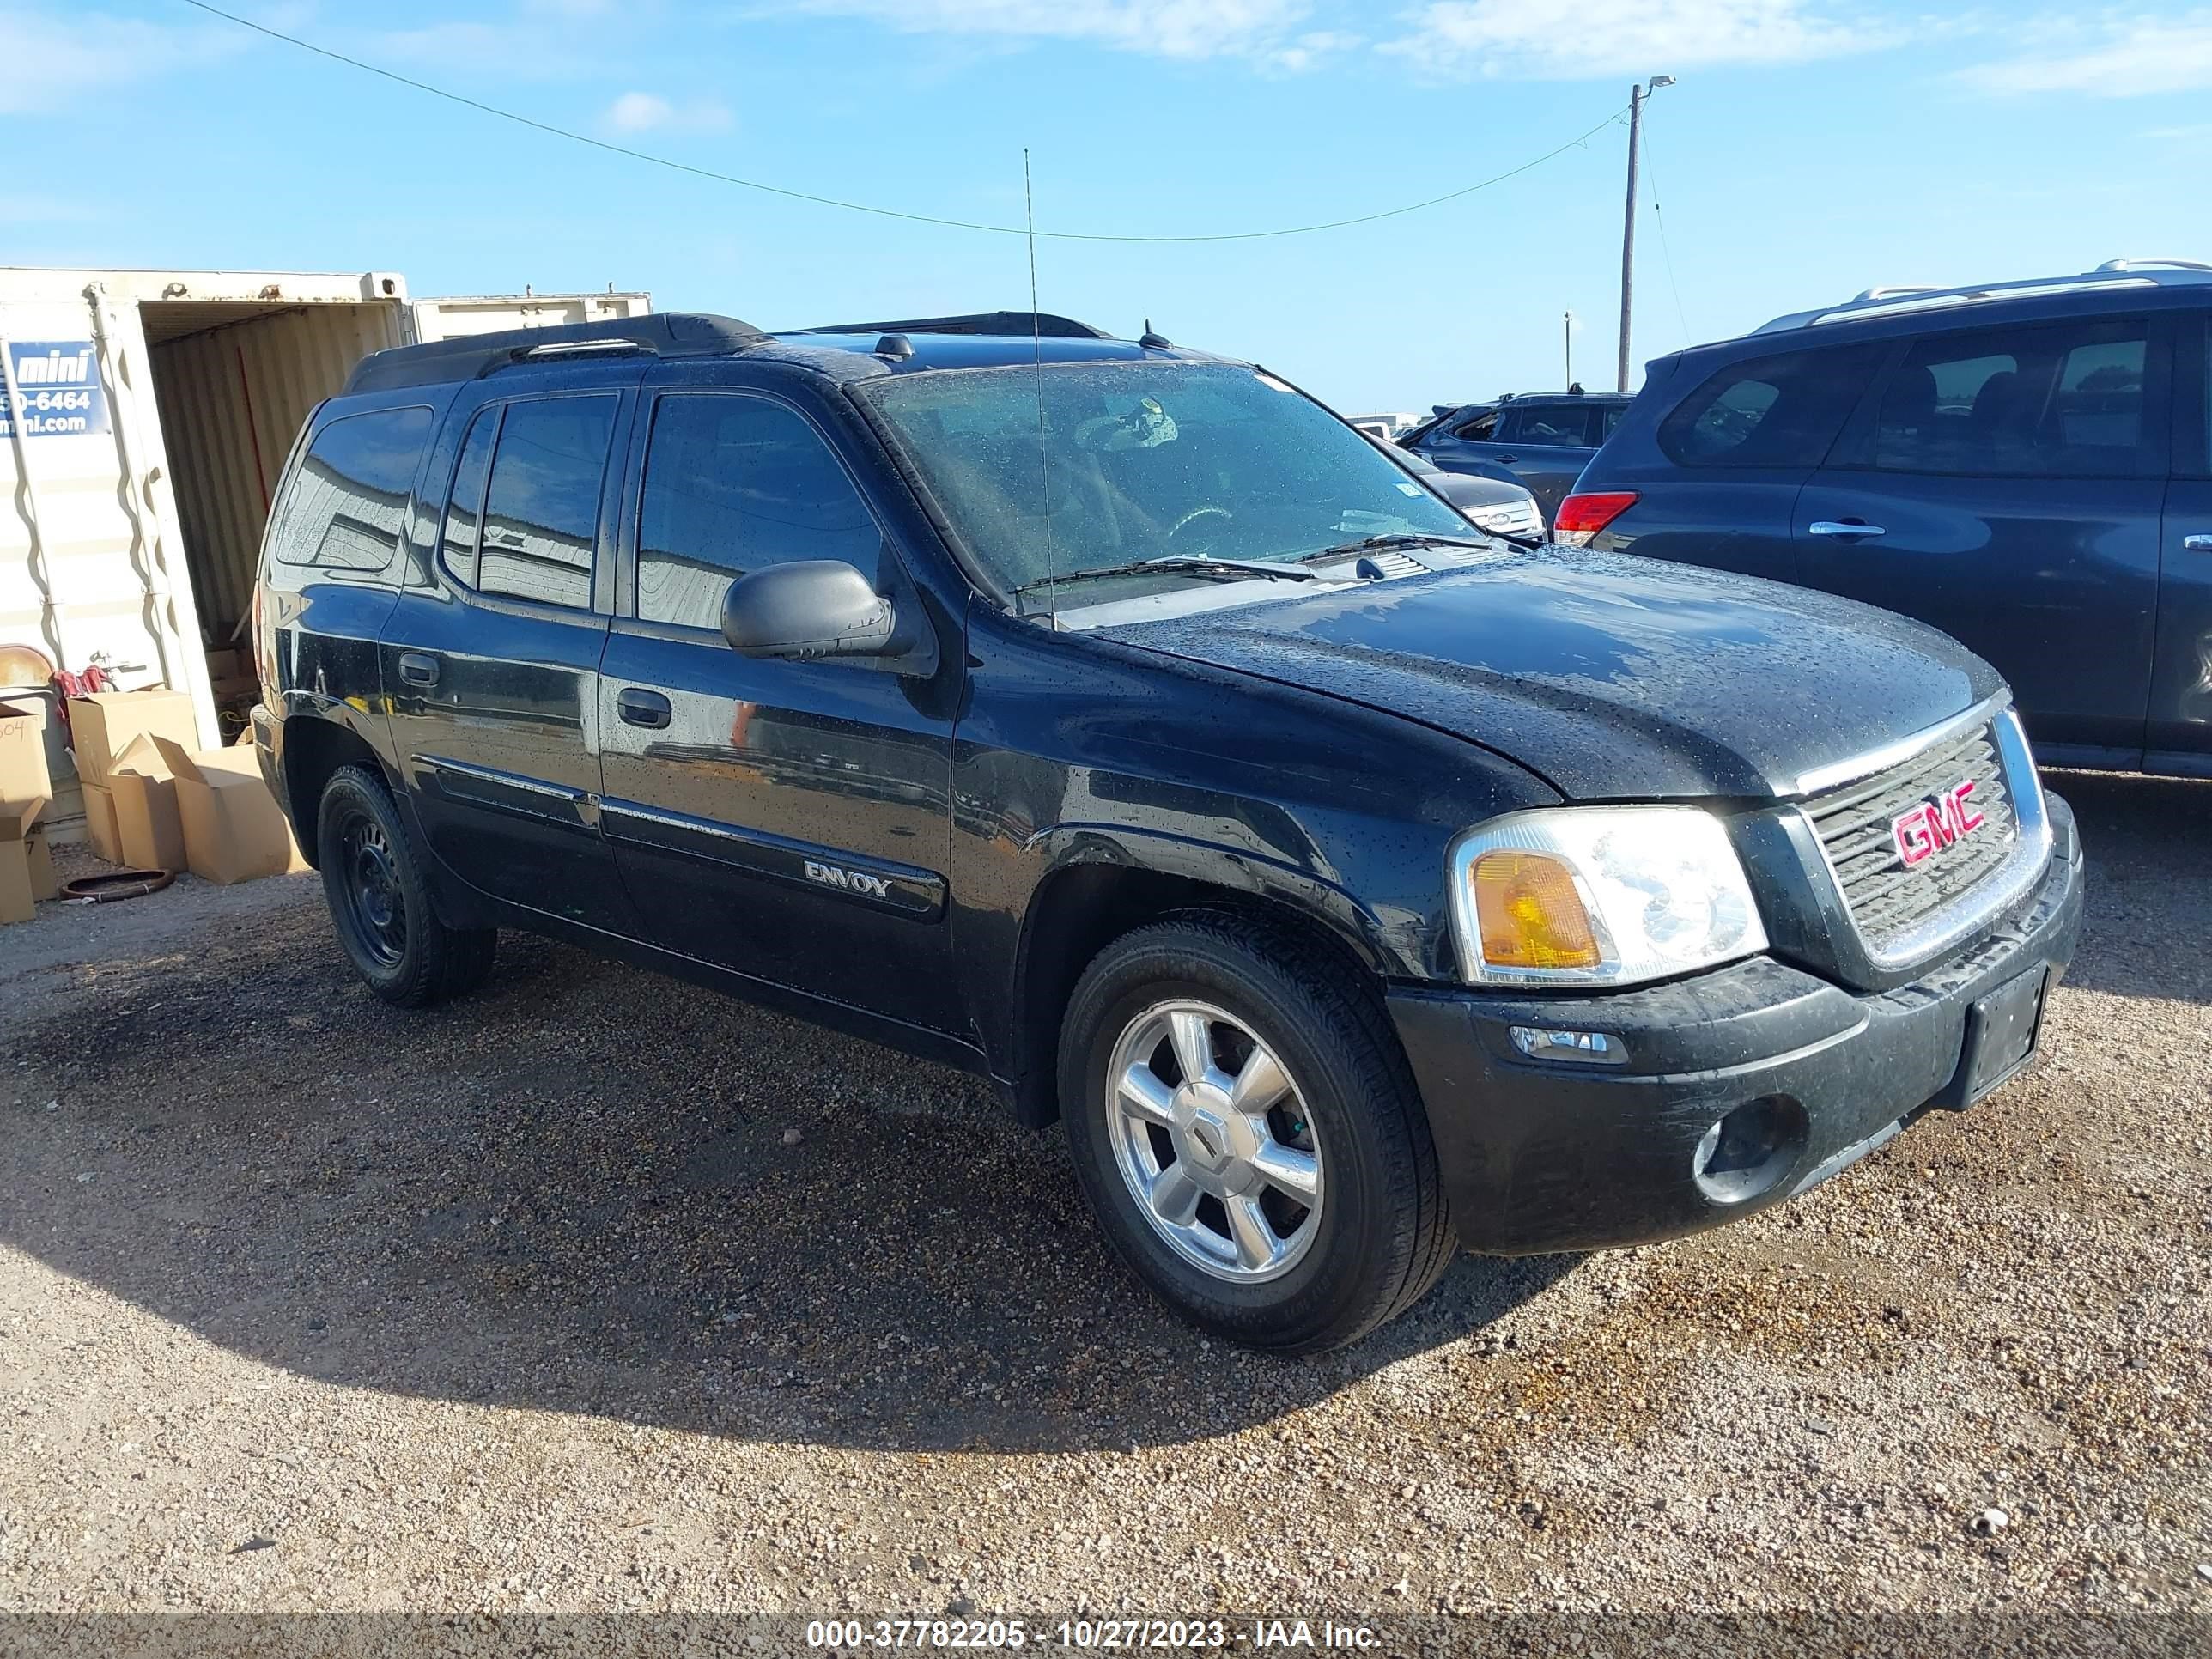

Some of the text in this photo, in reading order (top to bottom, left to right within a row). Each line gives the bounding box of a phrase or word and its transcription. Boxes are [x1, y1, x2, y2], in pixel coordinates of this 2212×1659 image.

[17, 349, 90, 383] mini
[1891, 779, 1985, 867] GMC
[804, 860, 894, 897] ENVOY
